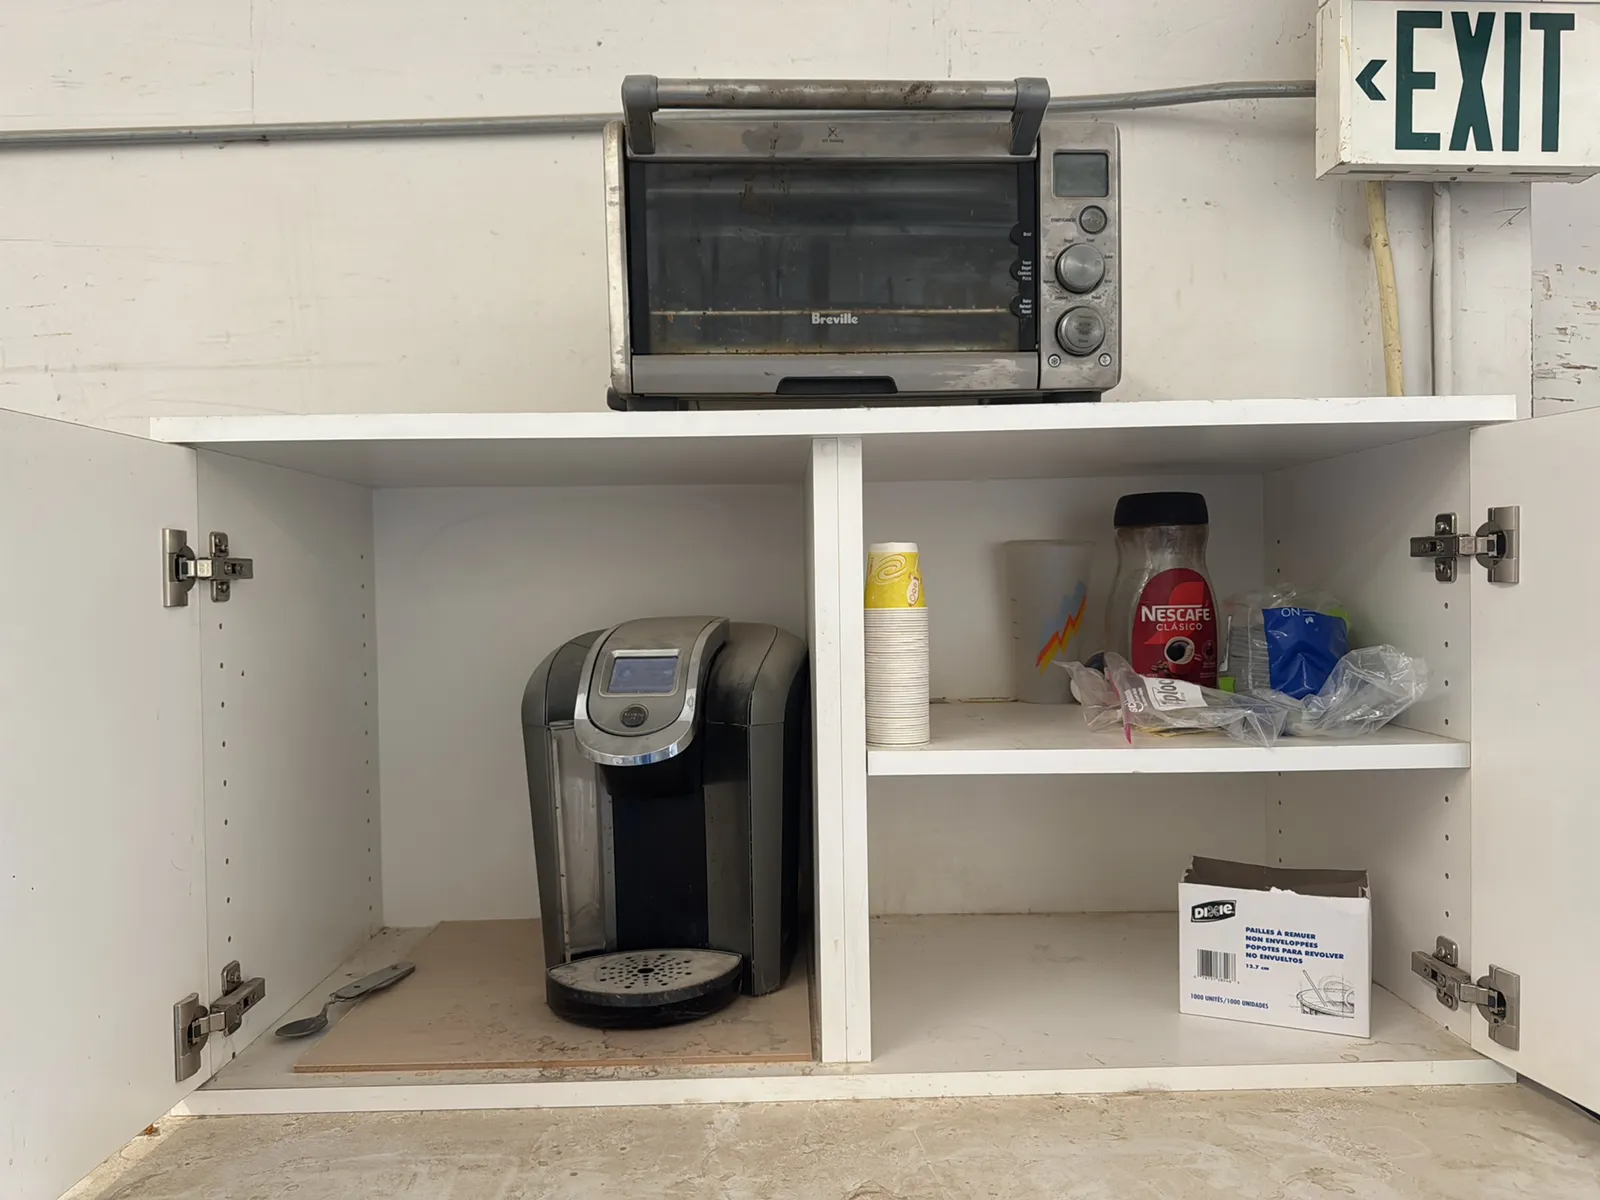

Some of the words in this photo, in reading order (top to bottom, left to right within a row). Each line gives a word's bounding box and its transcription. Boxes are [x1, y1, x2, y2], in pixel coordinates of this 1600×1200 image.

[1395, 10, 1575, 152] EXIT
[811, 312, 859, 325] Breville
[1245, 926, 1275, 936] PAILLES
[1284, 930, 1317, 940] REMUER
[1245, 935, 1264, 943] NON
[1265, 937, 1319, 949] ENVELOPPÉES
[1245, 943, 1280, 953] POPOTES
[1281, 947, 1303, 956] PARA
[1304, 950, 1345, 960] REVOLVER
[1259, 953, 1304, 965] ENVUELTOS
[1190, 993, 1204, 1001] 1000
[1241, 1000, 1269, 1010] UNIDADES
